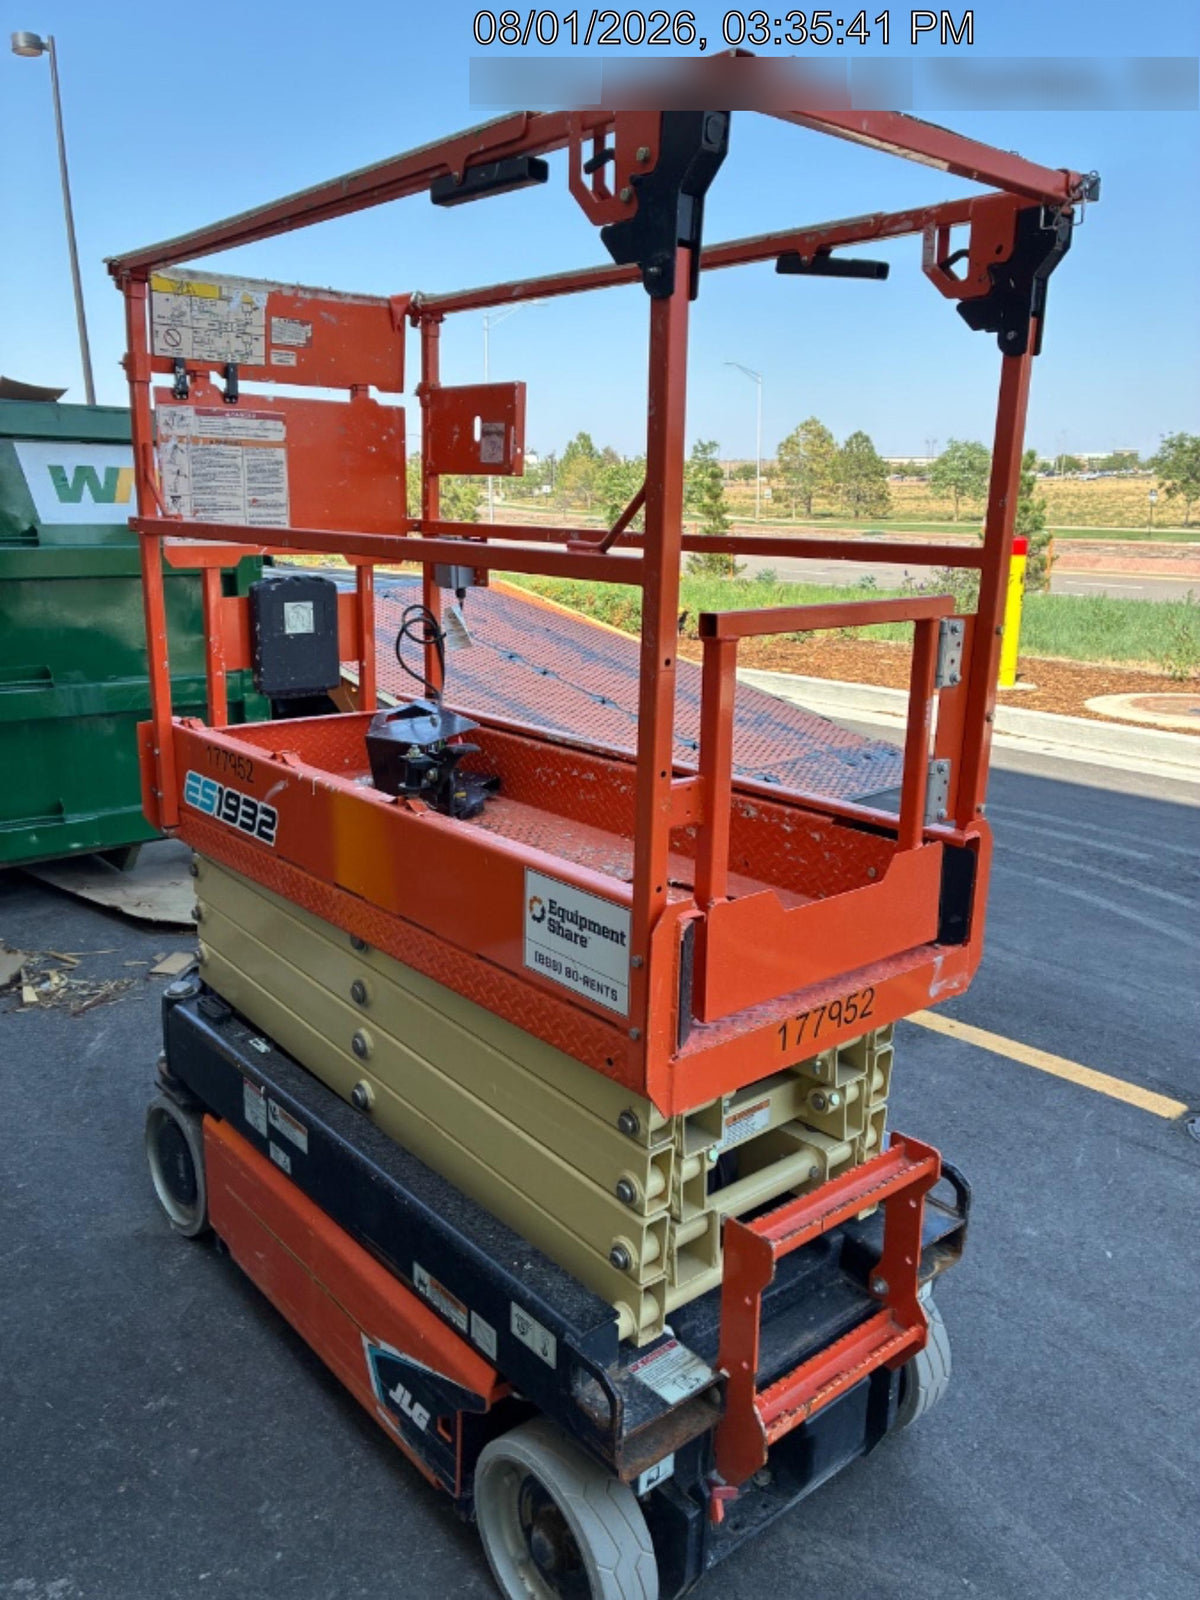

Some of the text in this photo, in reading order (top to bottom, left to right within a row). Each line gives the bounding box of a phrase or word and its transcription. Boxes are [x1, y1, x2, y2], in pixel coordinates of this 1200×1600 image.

[206, 746, 254, 784] 177952
[185, 770, 278, 846] ES1932
[547, 898, 627, 948] Equipment
[547, 919, 589, 949] Share
[778, 987, 876, 1052] 177952
[388, 1382, 431, 1432] JLG
